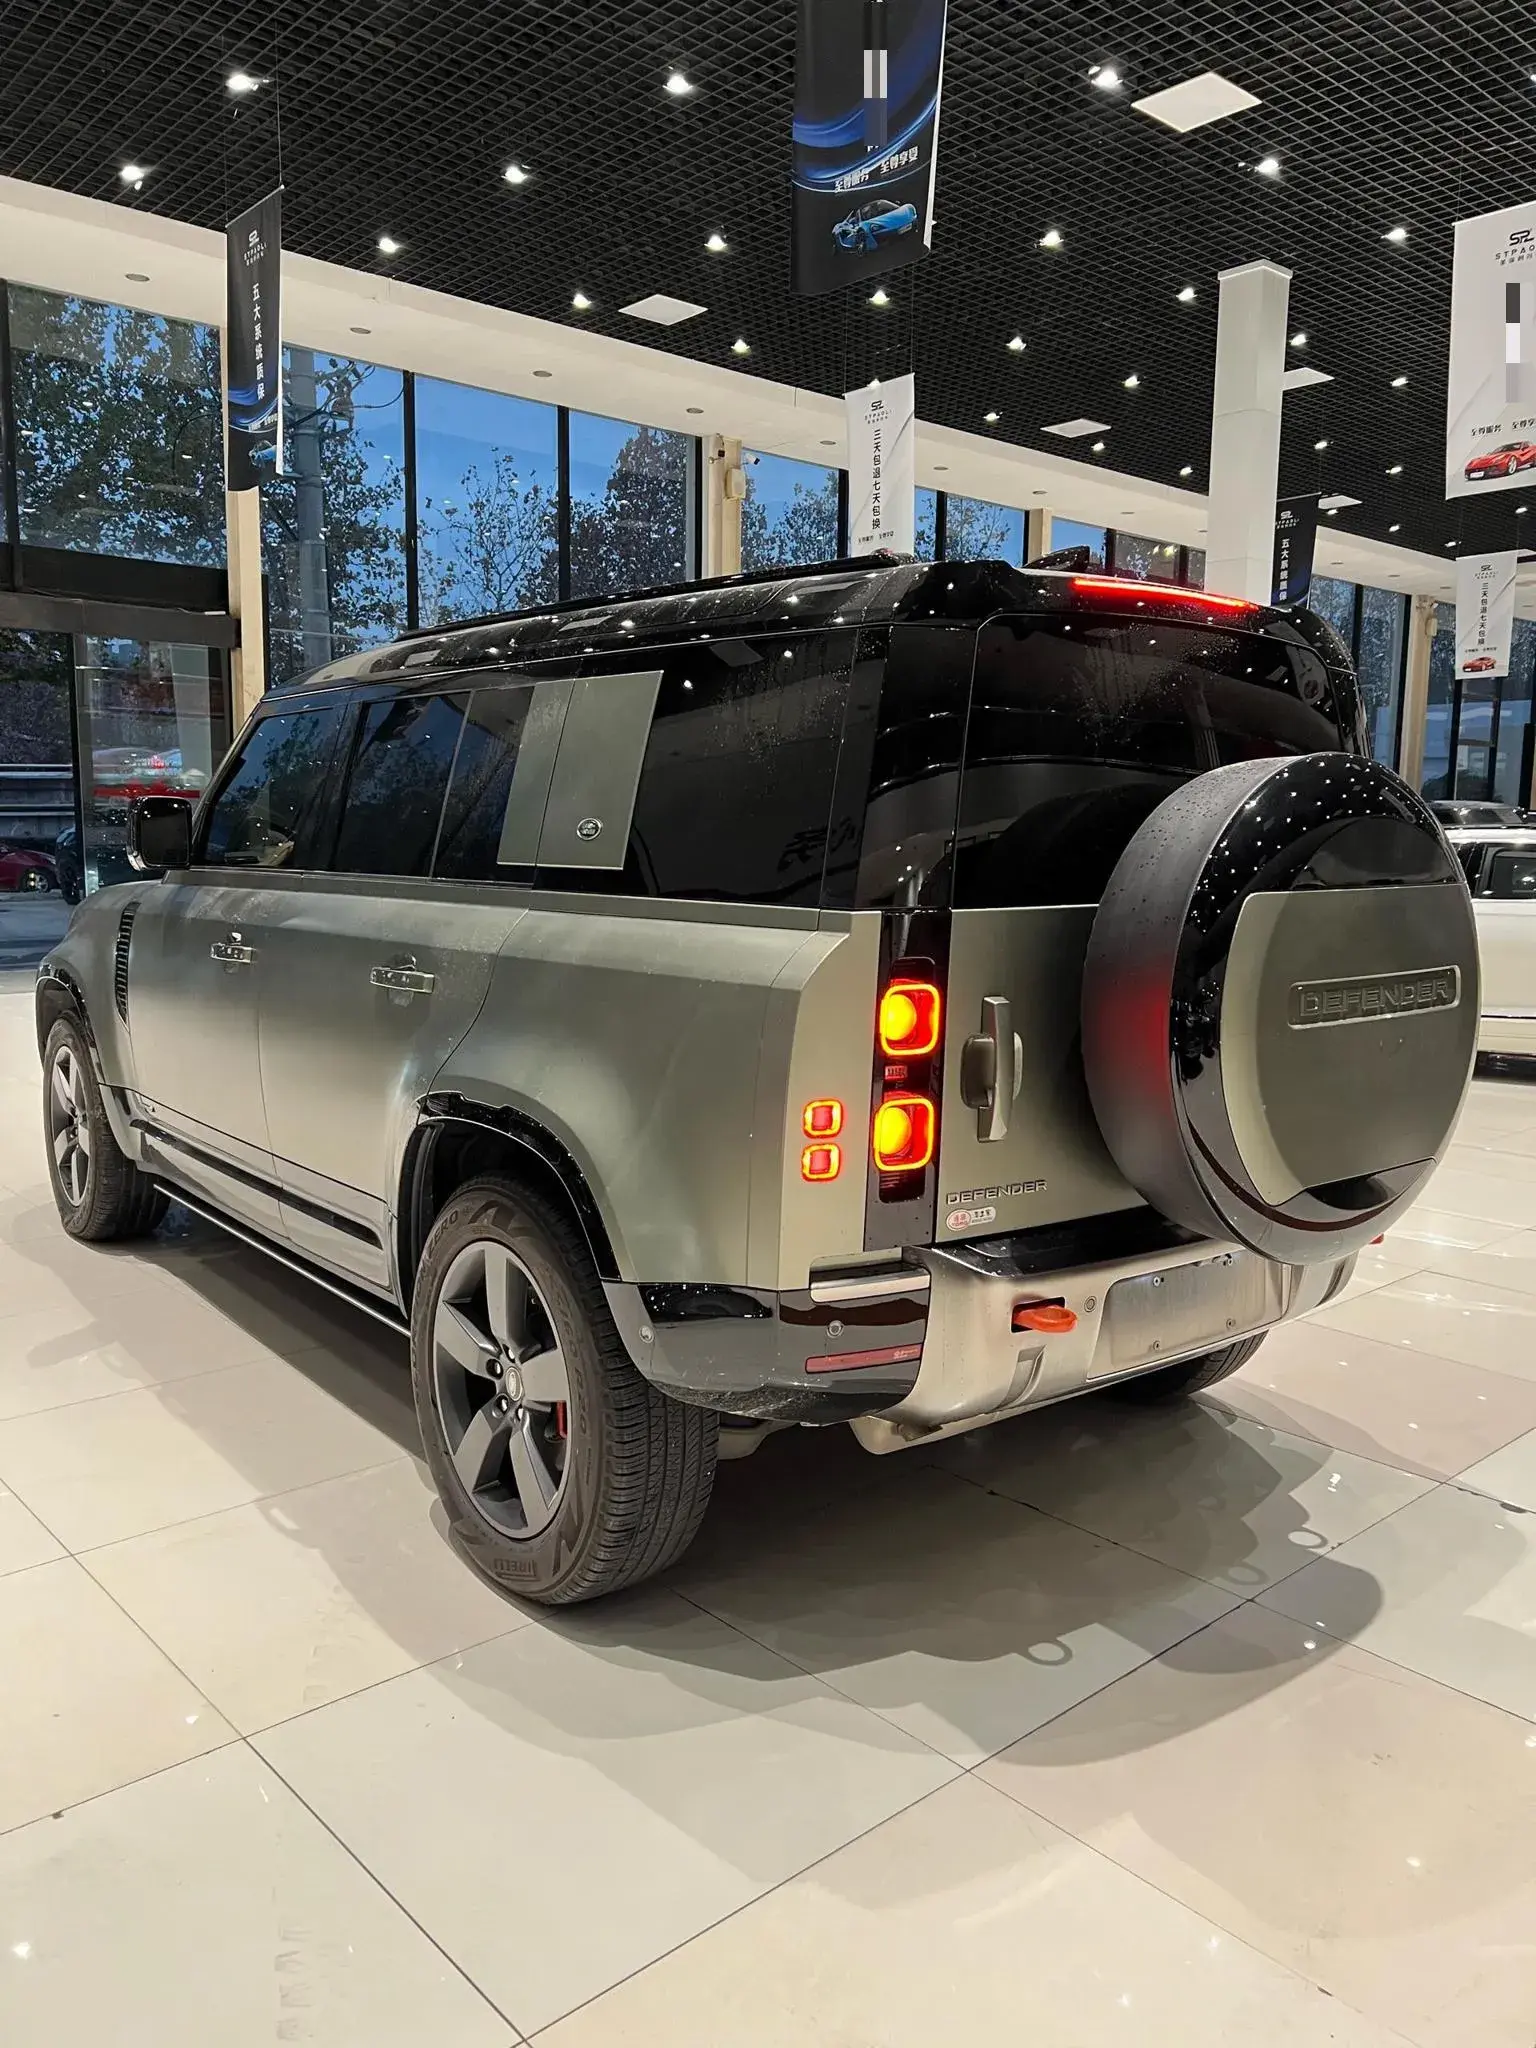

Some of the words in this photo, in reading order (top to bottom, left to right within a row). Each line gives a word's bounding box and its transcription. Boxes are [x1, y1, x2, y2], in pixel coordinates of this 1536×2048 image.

[252, 282, 265, 400] 五大系统质保
[872, 428, 881, 530] 三天包退七天包换
[1300, 978, 1449, 1018] DEFENDER
[946, 1179, 1047, 1205] DEFENDER
